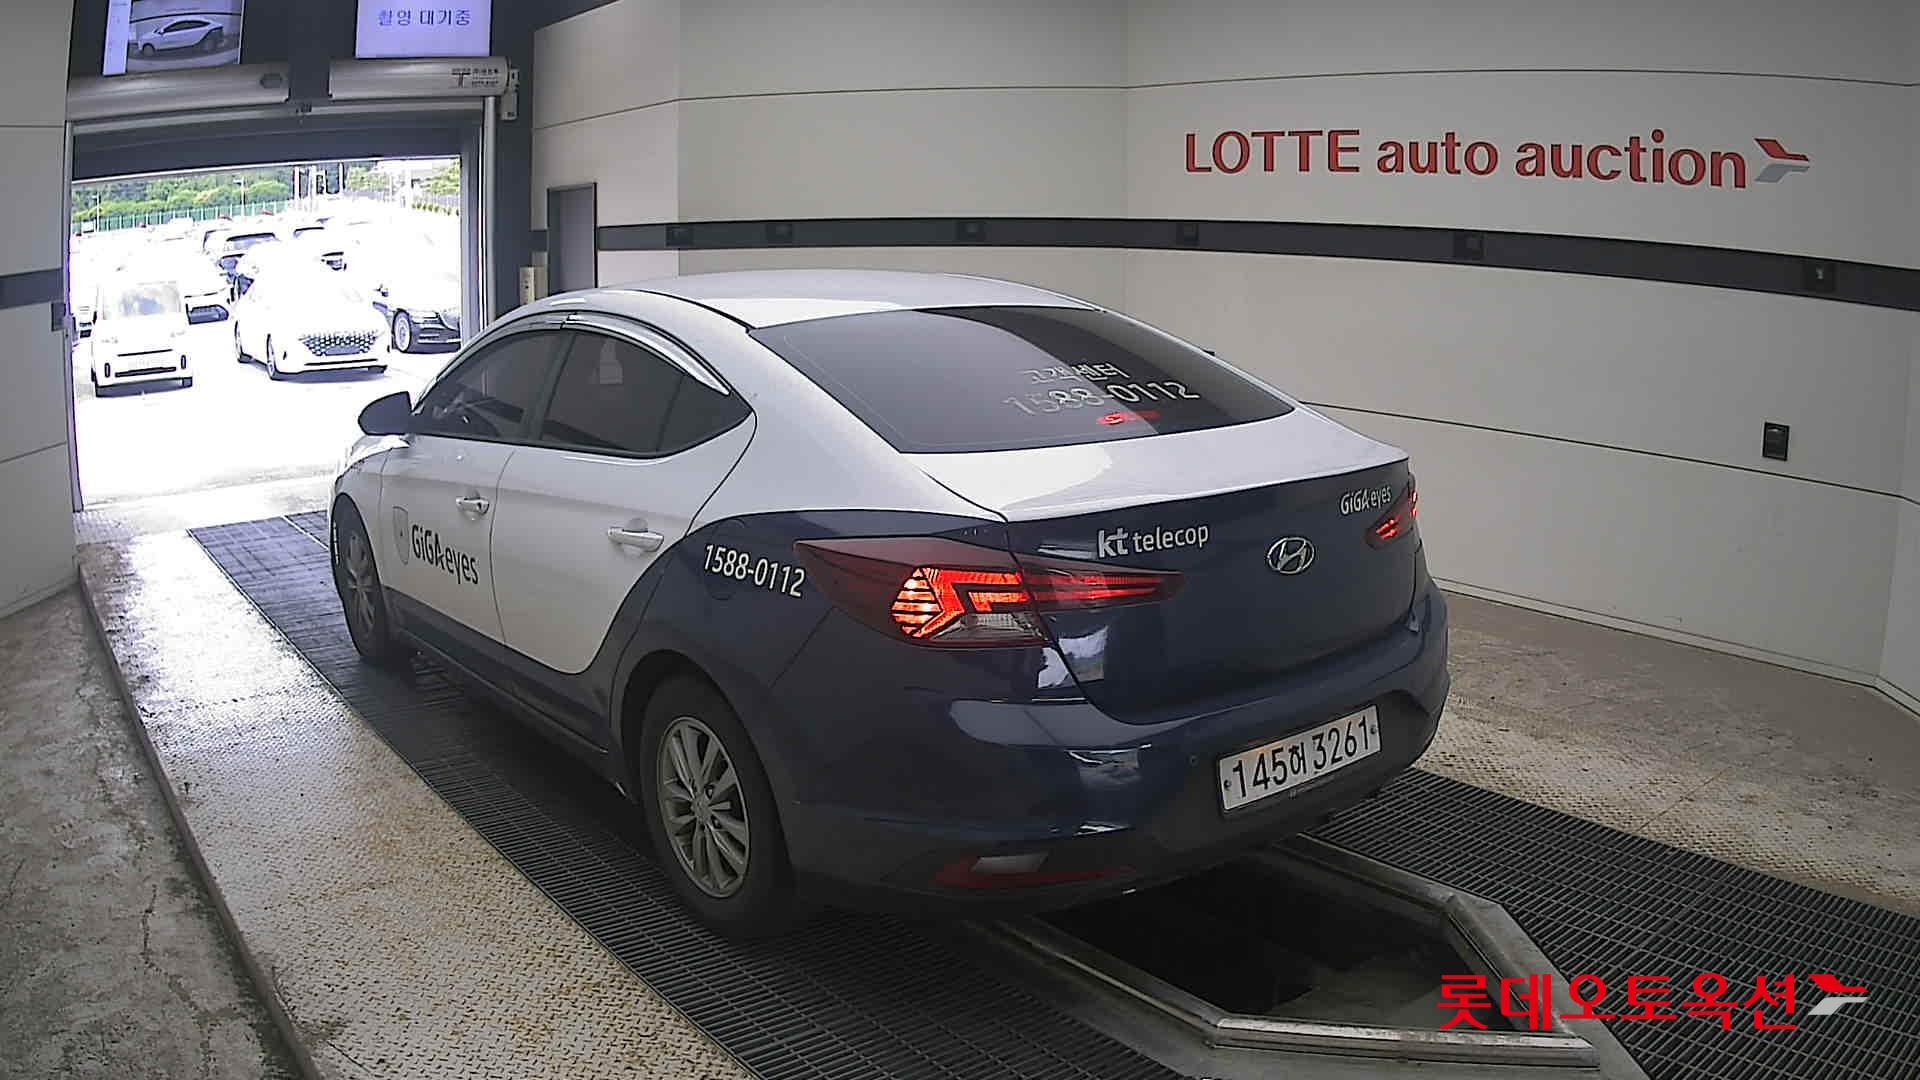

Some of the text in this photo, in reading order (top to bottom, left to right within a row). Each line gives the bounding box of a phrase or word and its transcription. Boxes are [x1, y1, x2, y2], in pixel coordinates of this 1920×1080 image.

[419, 9, 471, 26] 대기중
[1185, 129, 1747, 189] LOTTE auto auction
[1097, 524, 1209, 558] kt telecop
[704, 544, 806, 598] 1588-0112
[1312, 714, 1370, 771] 3261
